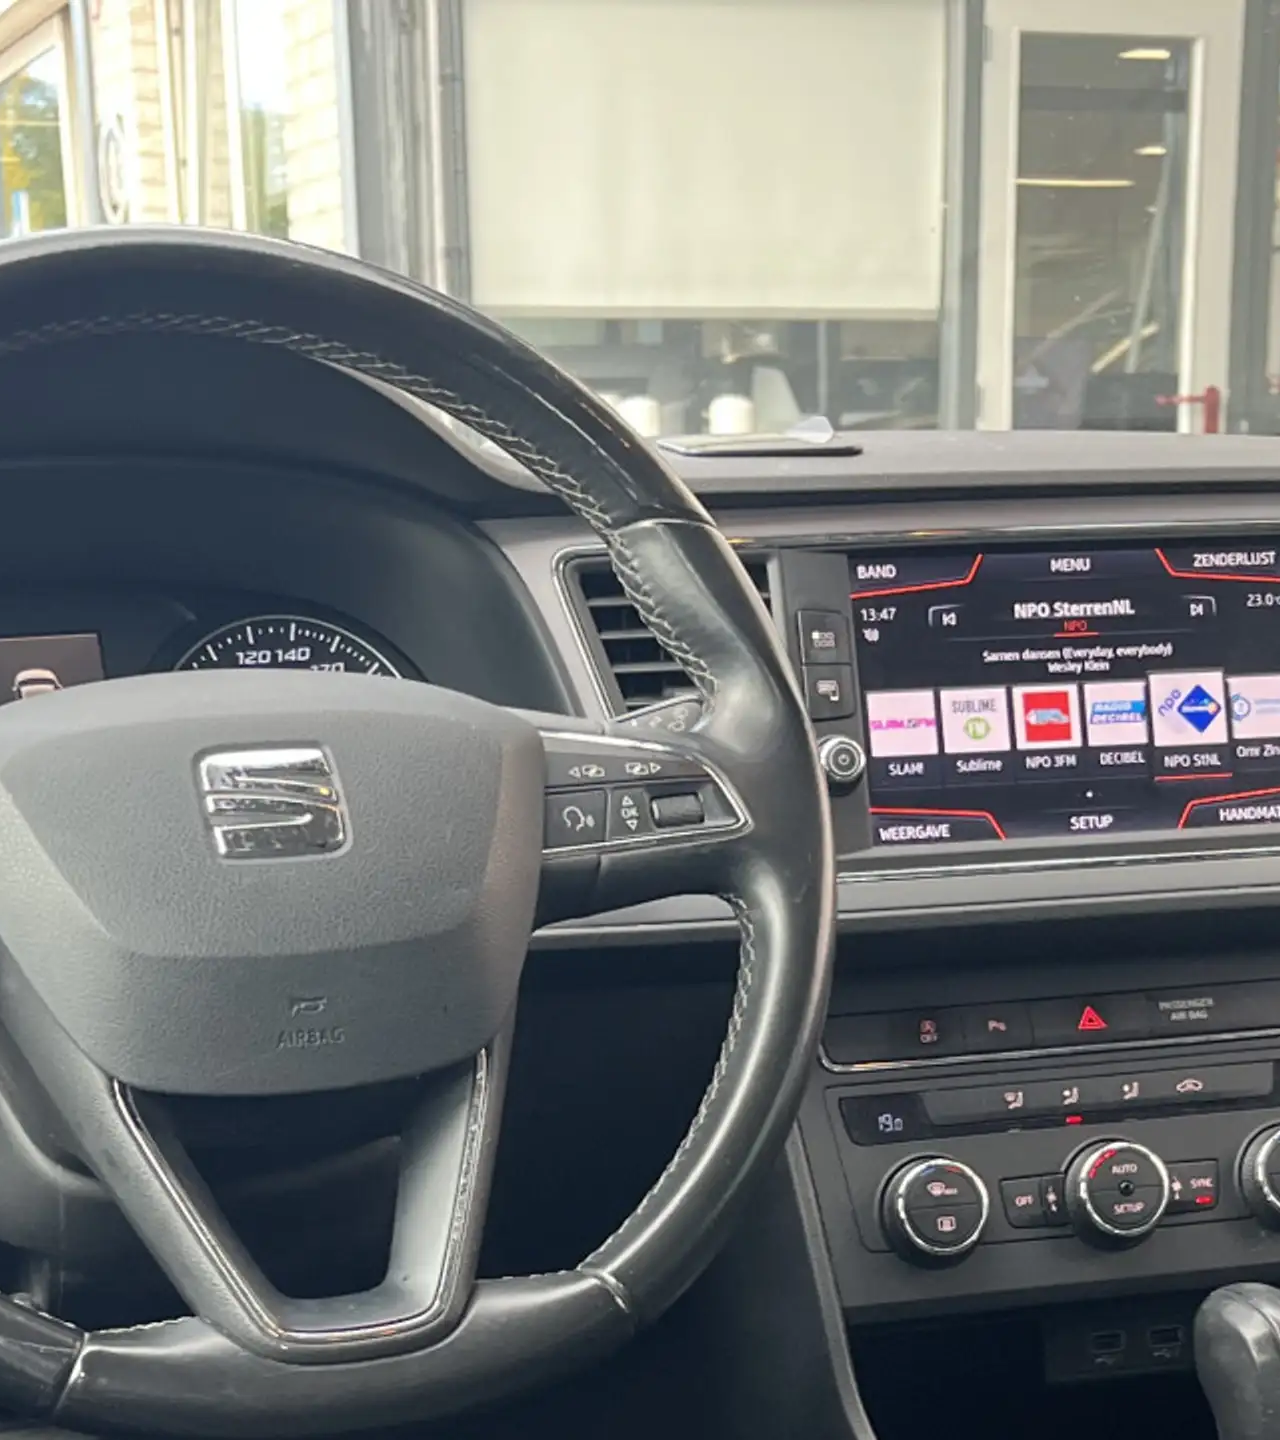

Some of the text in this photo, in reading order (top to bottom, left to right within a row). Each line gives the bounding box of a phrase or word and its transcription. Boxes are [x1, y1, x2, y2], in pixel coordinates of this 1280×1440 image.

[856, 564, 897, 579] BAND
[1050, 558, 1091, 572] MENU
[860, 607, 897, 622] 13:47
[1014, 599, 1136, 619] NPO SterrenNL
[1064, 620, 1088, 631] NPO
[235, 650, 272, 666] 120
[274, 646, 312, 663] 140
[982, 650, 1020, 663] Samen
[1022, 648, 1062, 661] dansen
[1116, 643, 1173, 659] everybody)
[1047, 660, 1110, 675] Wesley Klein
[956, 757, 1003, 773] Sublime
[1025, 754, 1078, 769] NPO 3FM
[1099, 751, 1146, 766] DECIBEL
[1163, 755, 1191, 768] NPO
[1070, 814, 1113, 830] SETUP
[879, 824, 952, 841] WEERGAVE
[1111, 1163, 1138, 1175] AUTO
[1190, 1178, 1214, 1189] SYNC
[1113, 1202, 1145, 1216] SETUP
